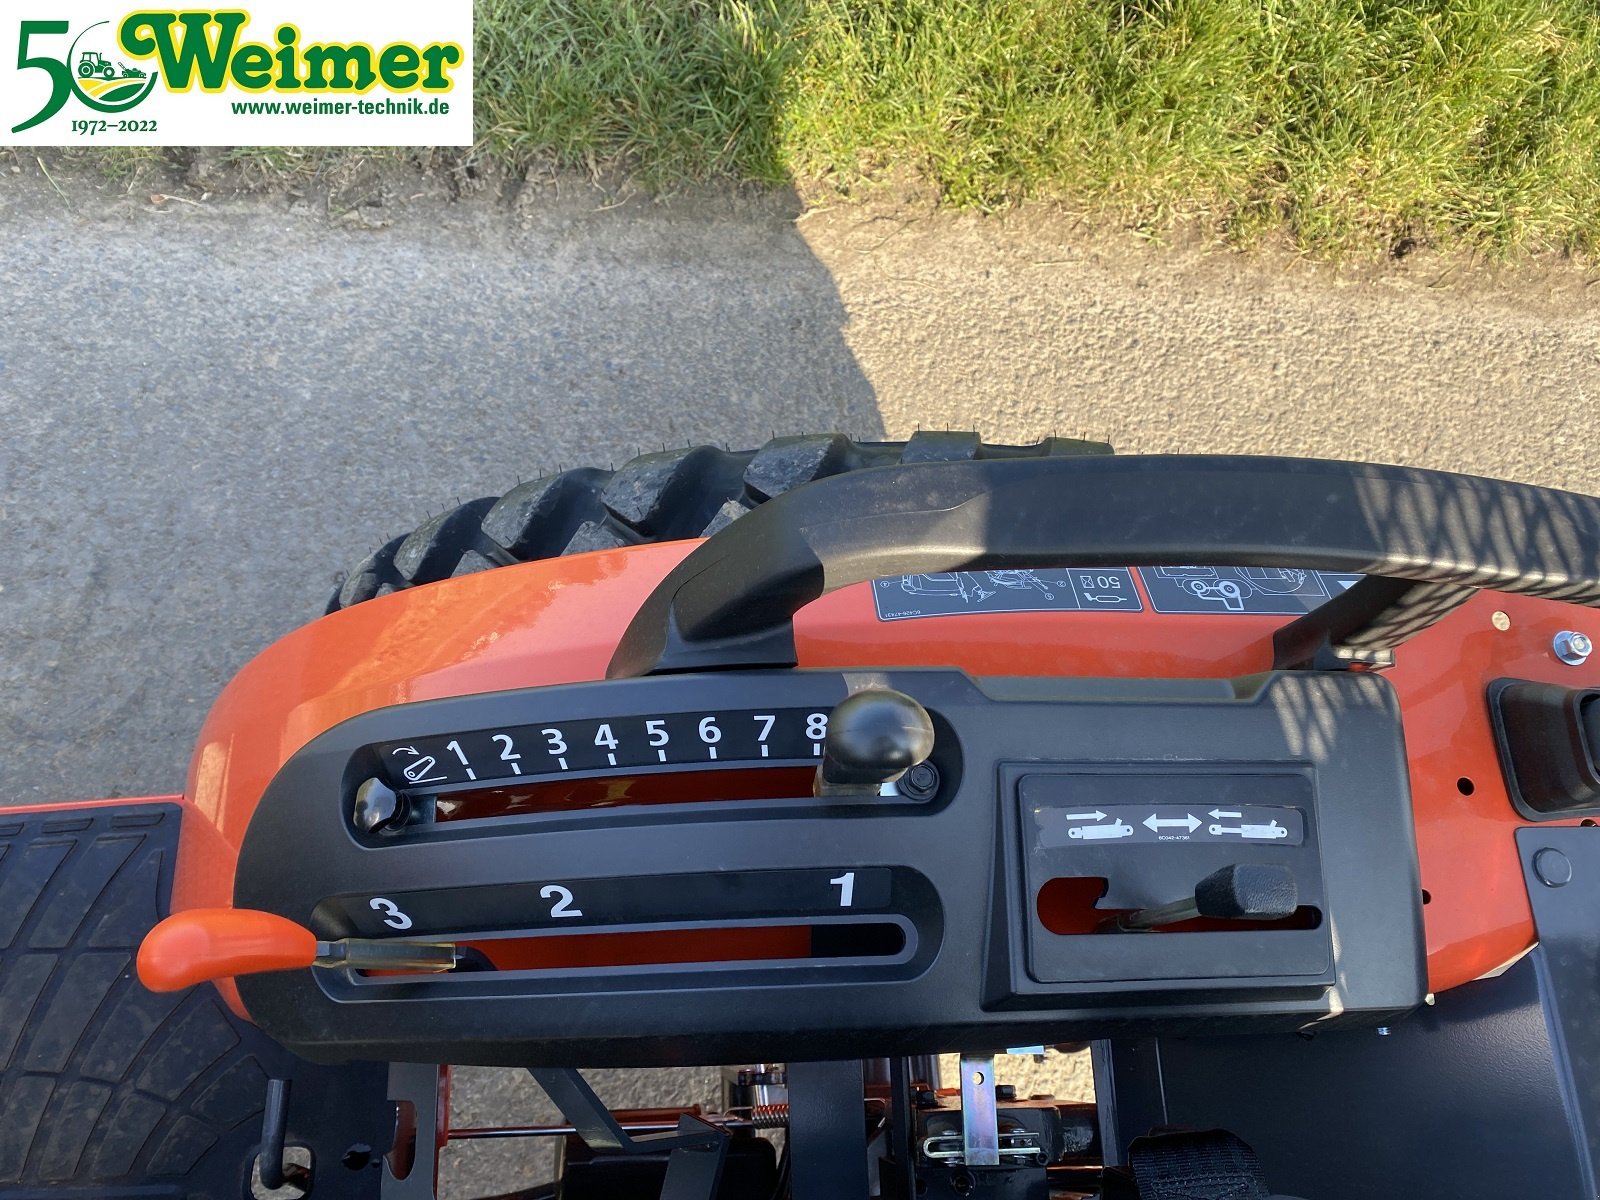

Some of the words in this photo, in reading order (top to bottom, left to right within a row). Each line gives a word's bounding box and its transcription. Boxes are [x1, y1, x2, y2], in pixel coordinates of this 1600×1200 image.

[1096, 575, 1121, 589] 50
[447, 740, 469, 765] 1
[492, 734, 521, 761] 2
[541, 728, 568, 755] 3
[594, 723, 619, 750] 4
[645, 719, 669, 747] 5
[698, 716, 722, 743] 6
[753, 715, 776, 740] 7
[805, 713, 828, 740] 8
[369, 897, 412, 931] 3
[540, 885, 583, 918] 2
[830, 872, 855, 907] 1
